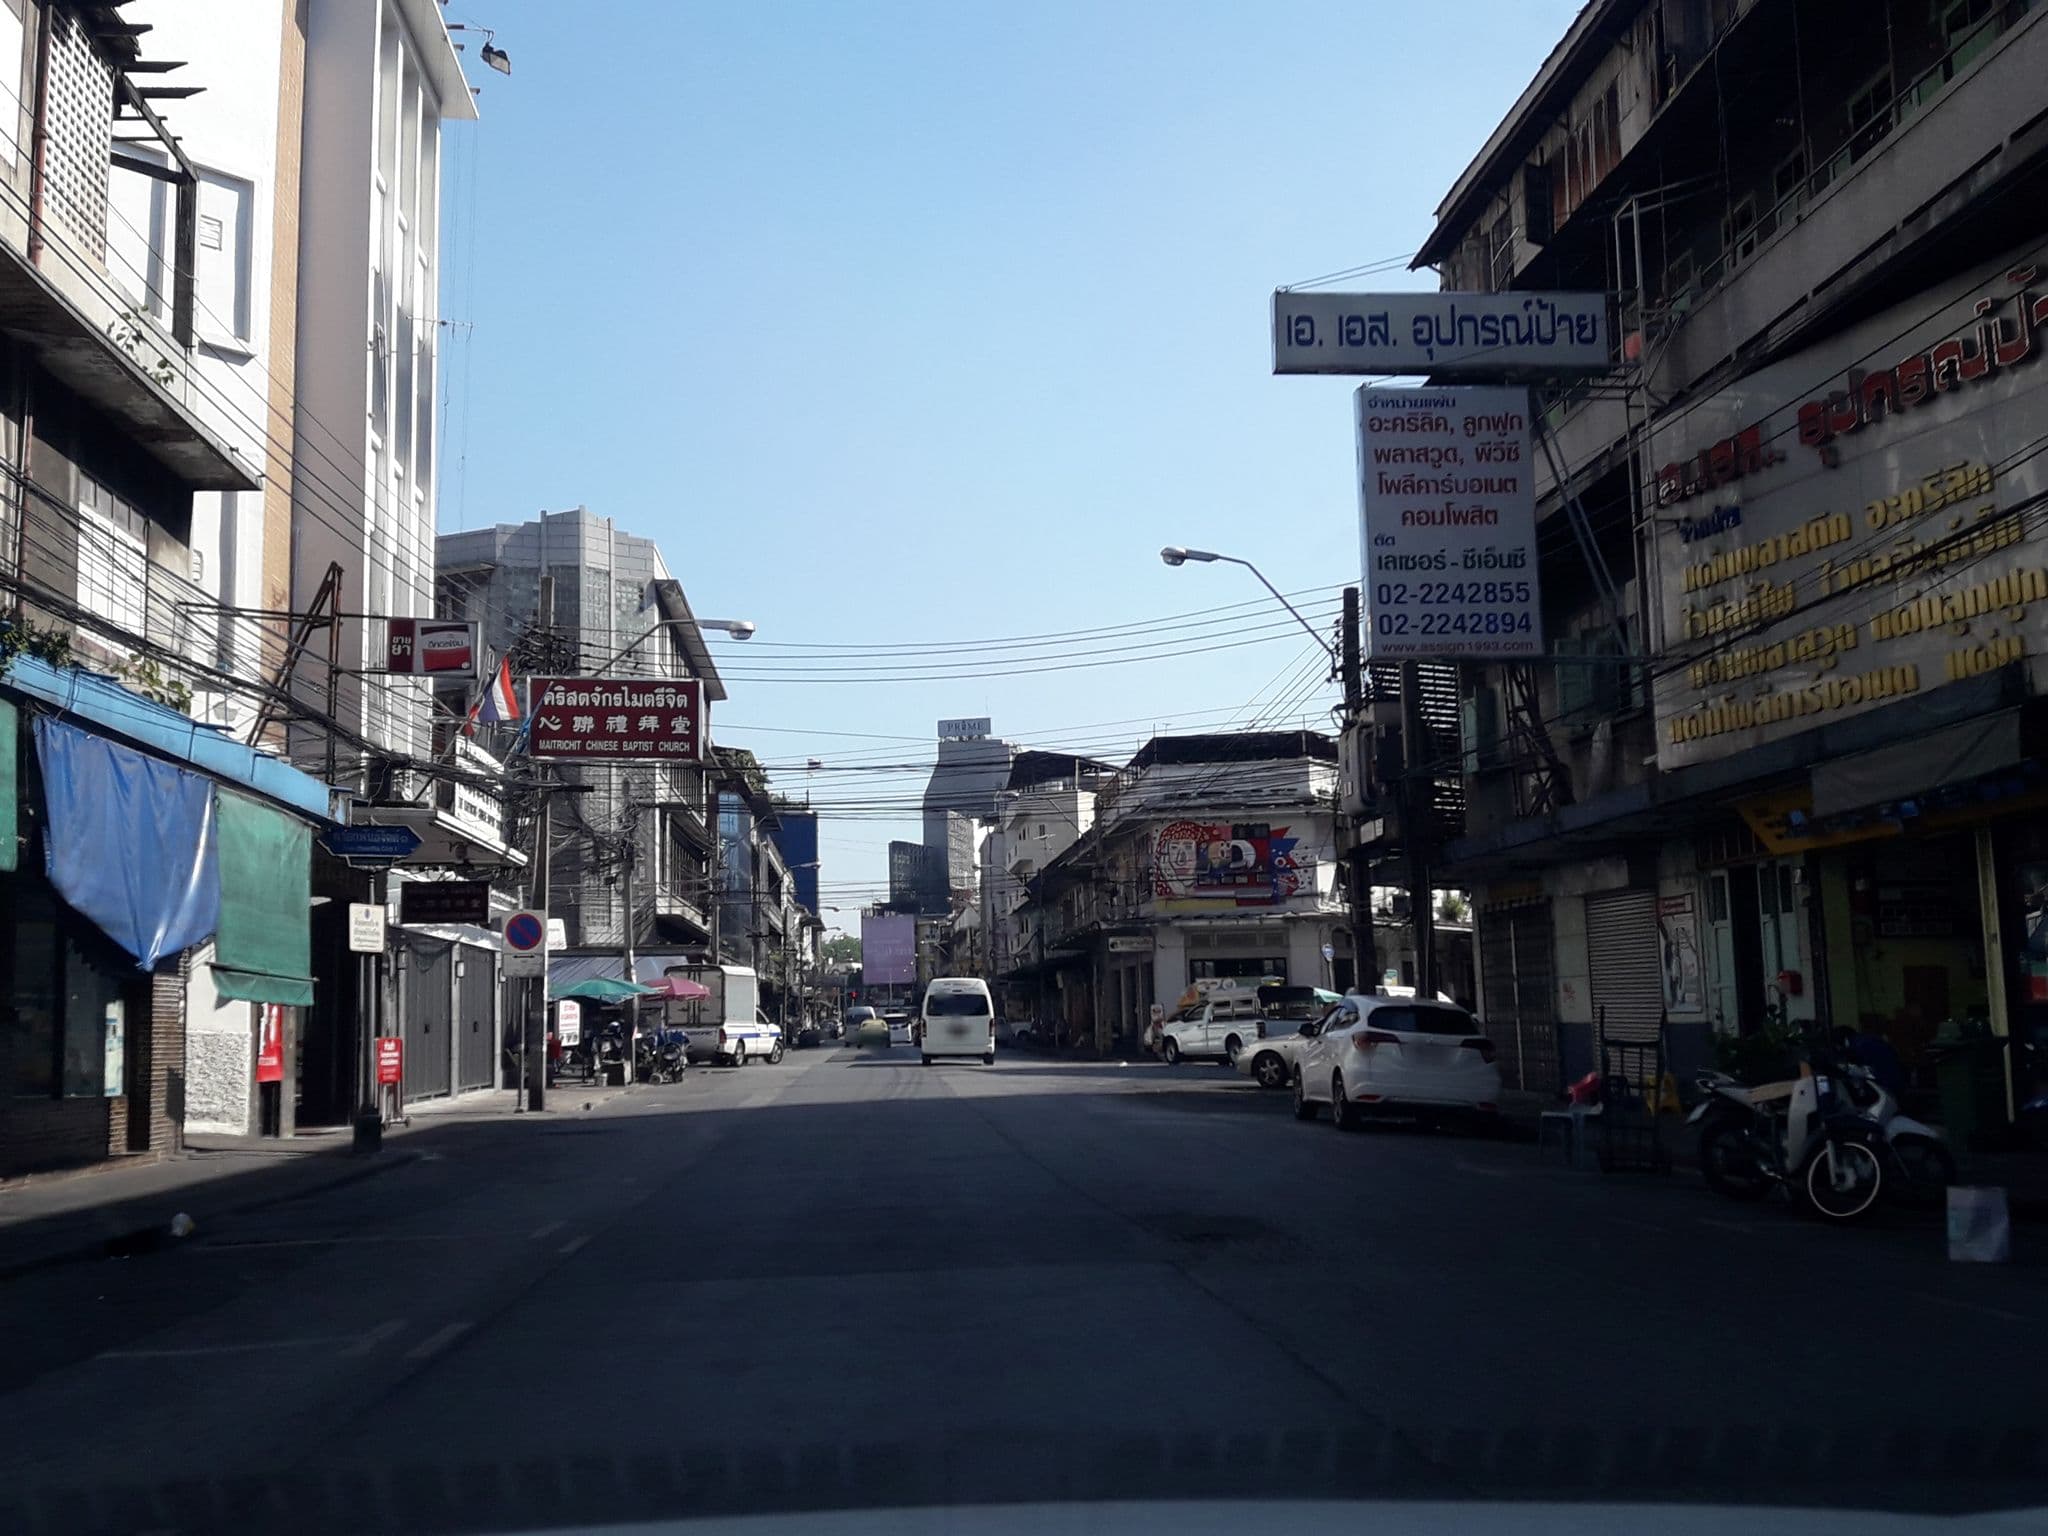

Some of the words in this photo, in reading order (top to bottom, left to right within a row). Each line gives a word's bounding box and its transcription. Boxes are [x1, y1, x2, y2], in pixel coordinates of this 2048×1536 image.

[1287, 314, 1323, 347] เอ.
[1338, 311, 1397, 347] เอส.
[1412, 299, 1597, 361] อุปกรณ์ป้าย
[1463, 411, 1523, 438] ลูกฟูก
[1377, 582, 1530, 605] 02-2242855
[1379, 612, 1533, 635] 02-2242894
[391, 644, 411, 656] ยา
[538, 740, 582, 752] MAITRICHIT
[586, 740, 618, 752] CHINESE
[622, 740, 653, 752] BAPTIST
[658, 740, 690, 752] CHURCH
